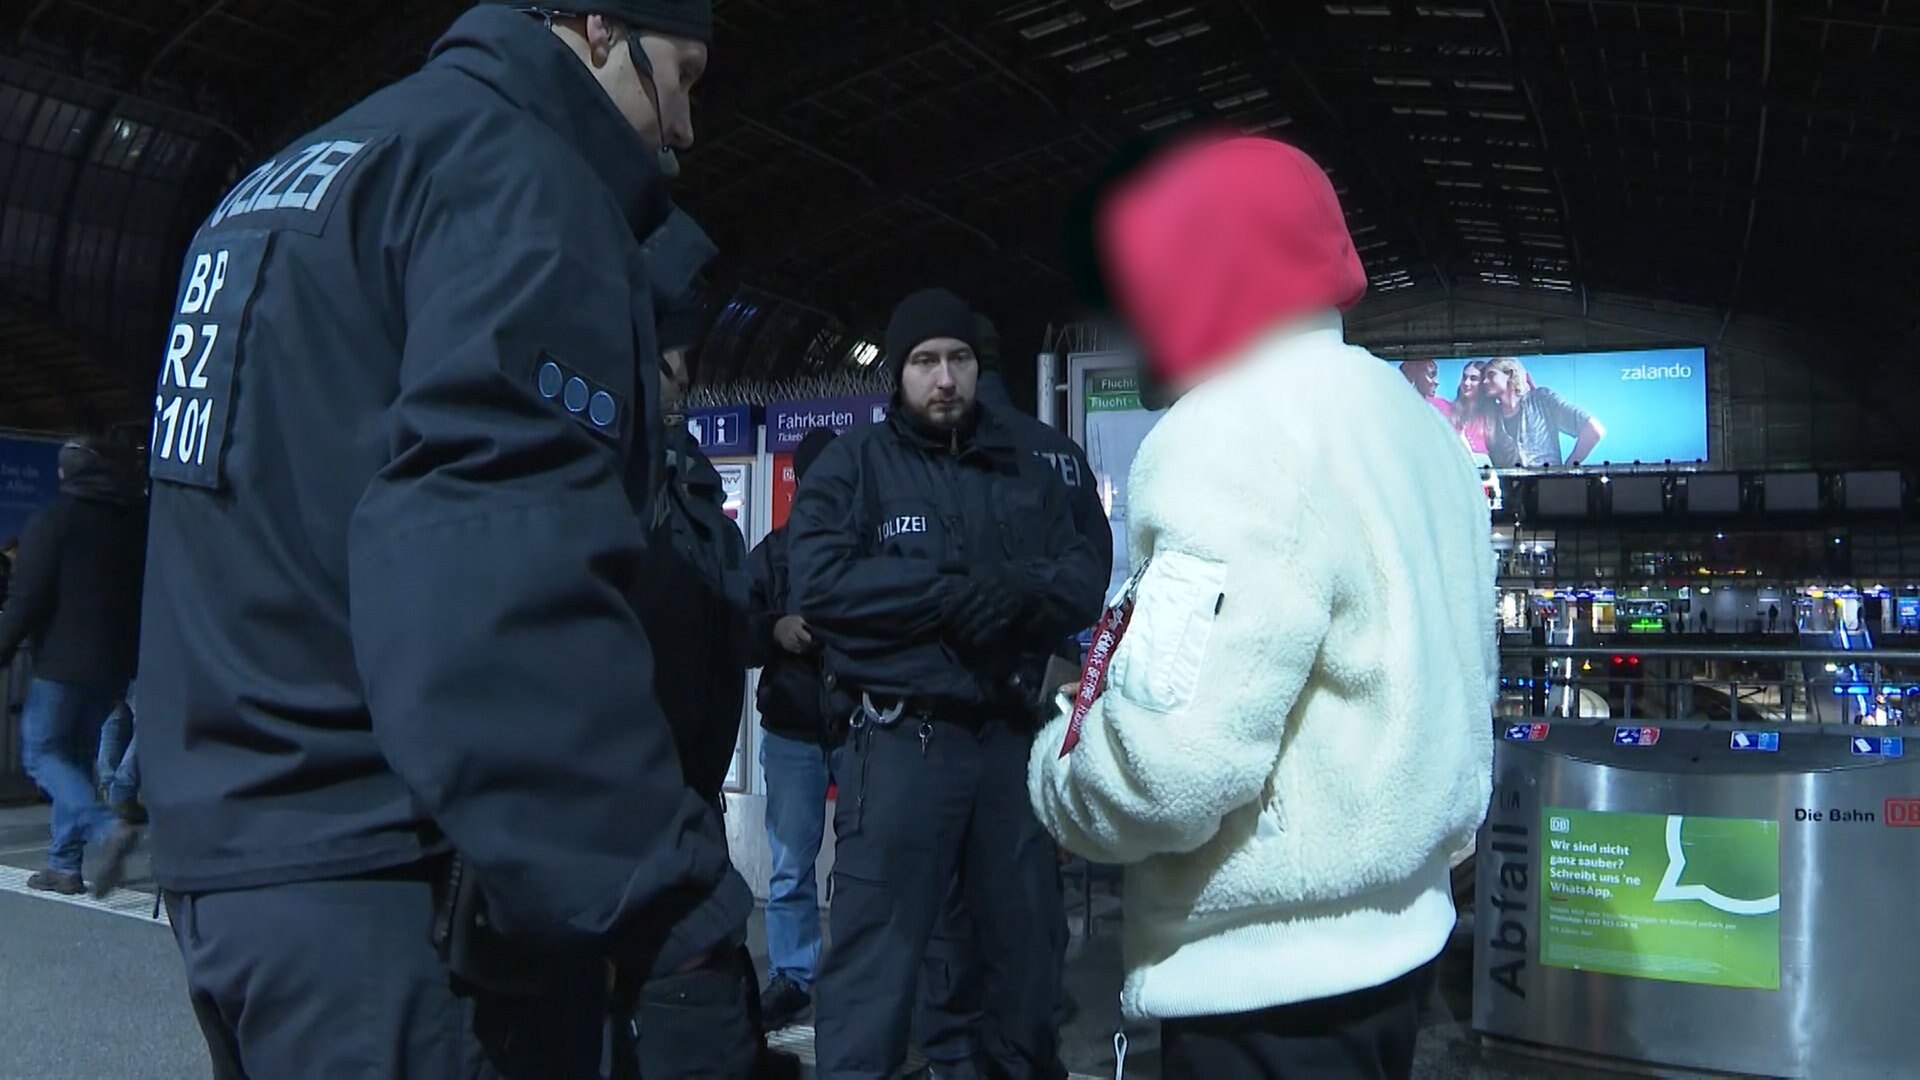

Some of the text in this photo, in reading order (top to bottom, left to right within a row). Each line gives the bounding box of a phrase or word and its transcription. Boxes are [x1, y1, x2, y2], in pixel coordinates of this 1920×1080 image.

[180, 250, 229, 314] BP
[162, 323, 219, 388] RZ
[1620, 363, 1692, 381] zalando
[777, 411, 853, 430] Fahrkarten
[777, 432, 804, 443] Tickets
[1794, 808, 1875, 822] Die Bahn
[1887, 801, 1920, 825] DB
[1550, 839, 1630, 856] Wir sind nicht
[1550, 855, 1625, 870] ganz sauber?
[1550, 867, 1597, 882] Schreibt
[1599, 875, 1620, 884] uns
[1550, 881, 1613, 899] WhatsApp.
[1489, 823, 1529, 999] Abfall
